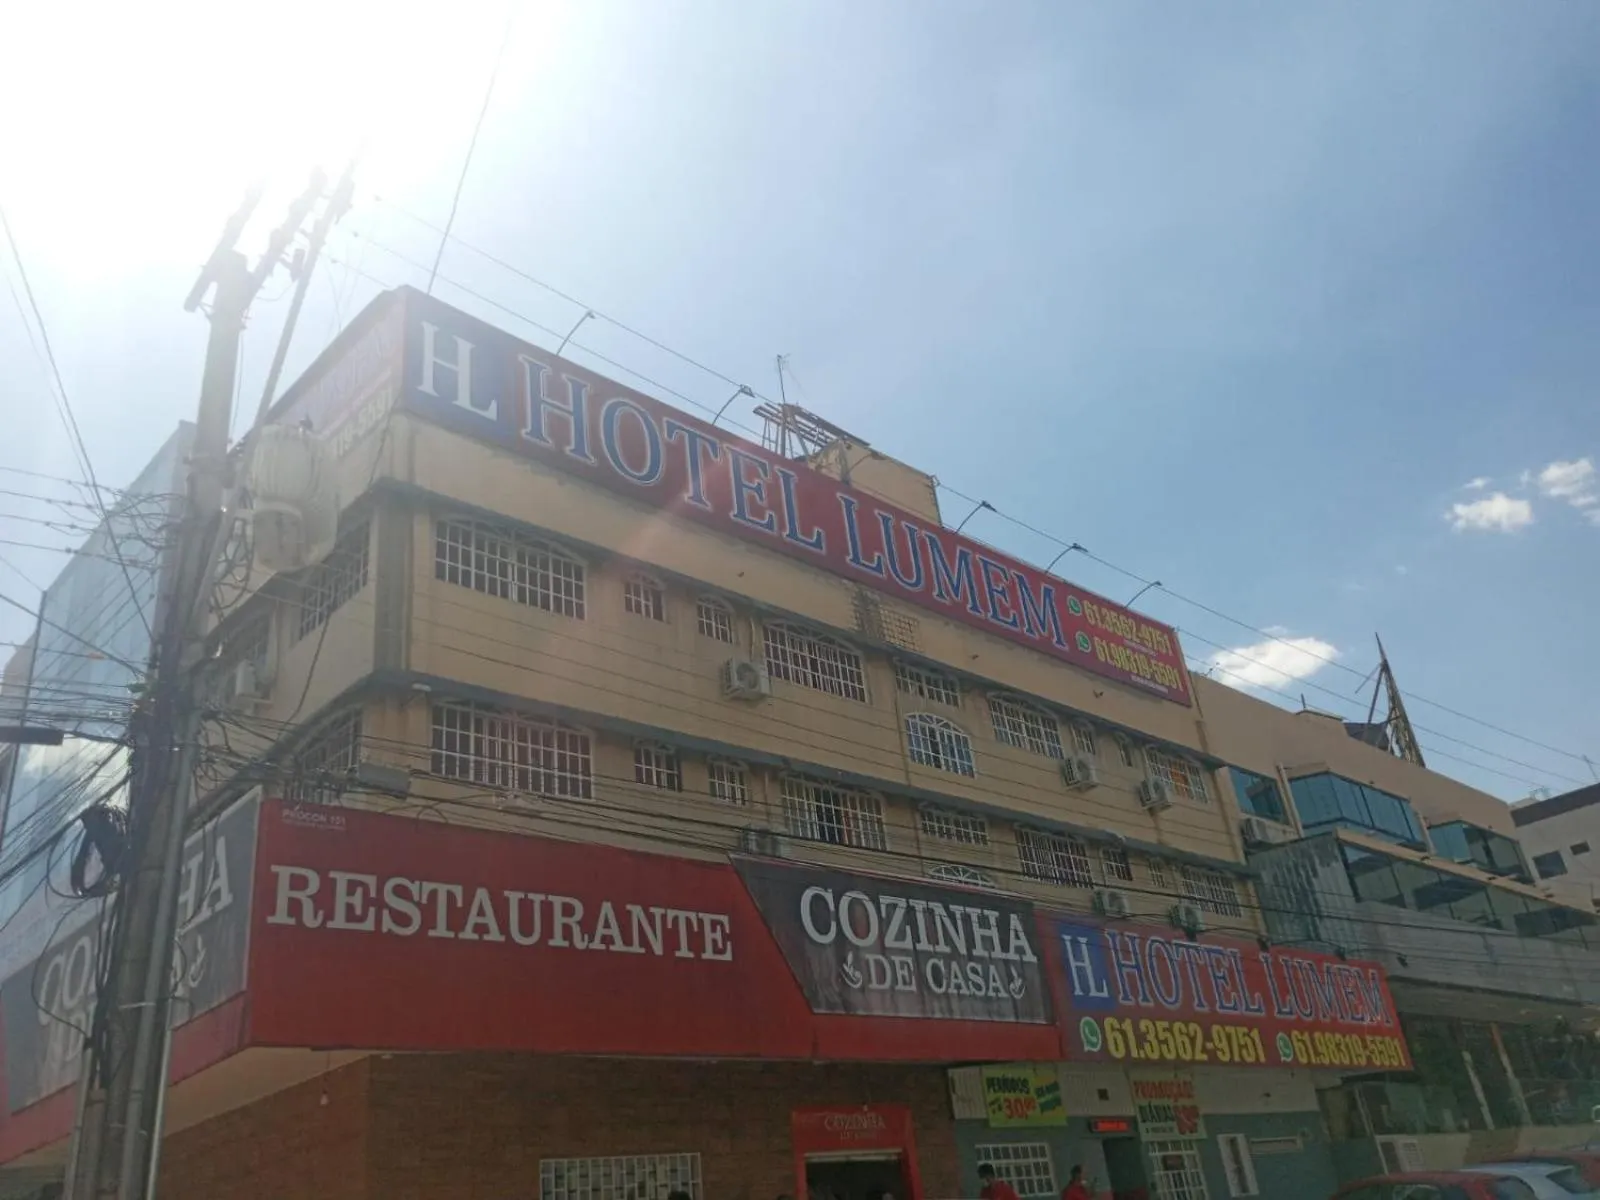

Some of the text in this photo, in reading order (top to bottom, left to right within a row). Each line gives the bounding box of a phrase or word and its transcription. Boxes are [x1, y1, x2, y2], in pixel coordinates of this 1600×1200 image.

[518, 353, 826, 554] HOTEL
[837, 492, 1070, 650] LUMEM
[1083, 600, 1173, 656] 61.3562-9751
[266, 865, 734, 961] RESTAURANTE
[800, 886, 1038, 963] COZINHA
[866, 953, 1009, 998] DE CASA
[1105, 928, 1266, 1017] HOTEL
[1259, 951, 1394, 1029] LUMEM
[1103, 1016, 1266, 1064] 61.3562-9751
[1292, 1031, 1407, 1069] 61.98319-5591
